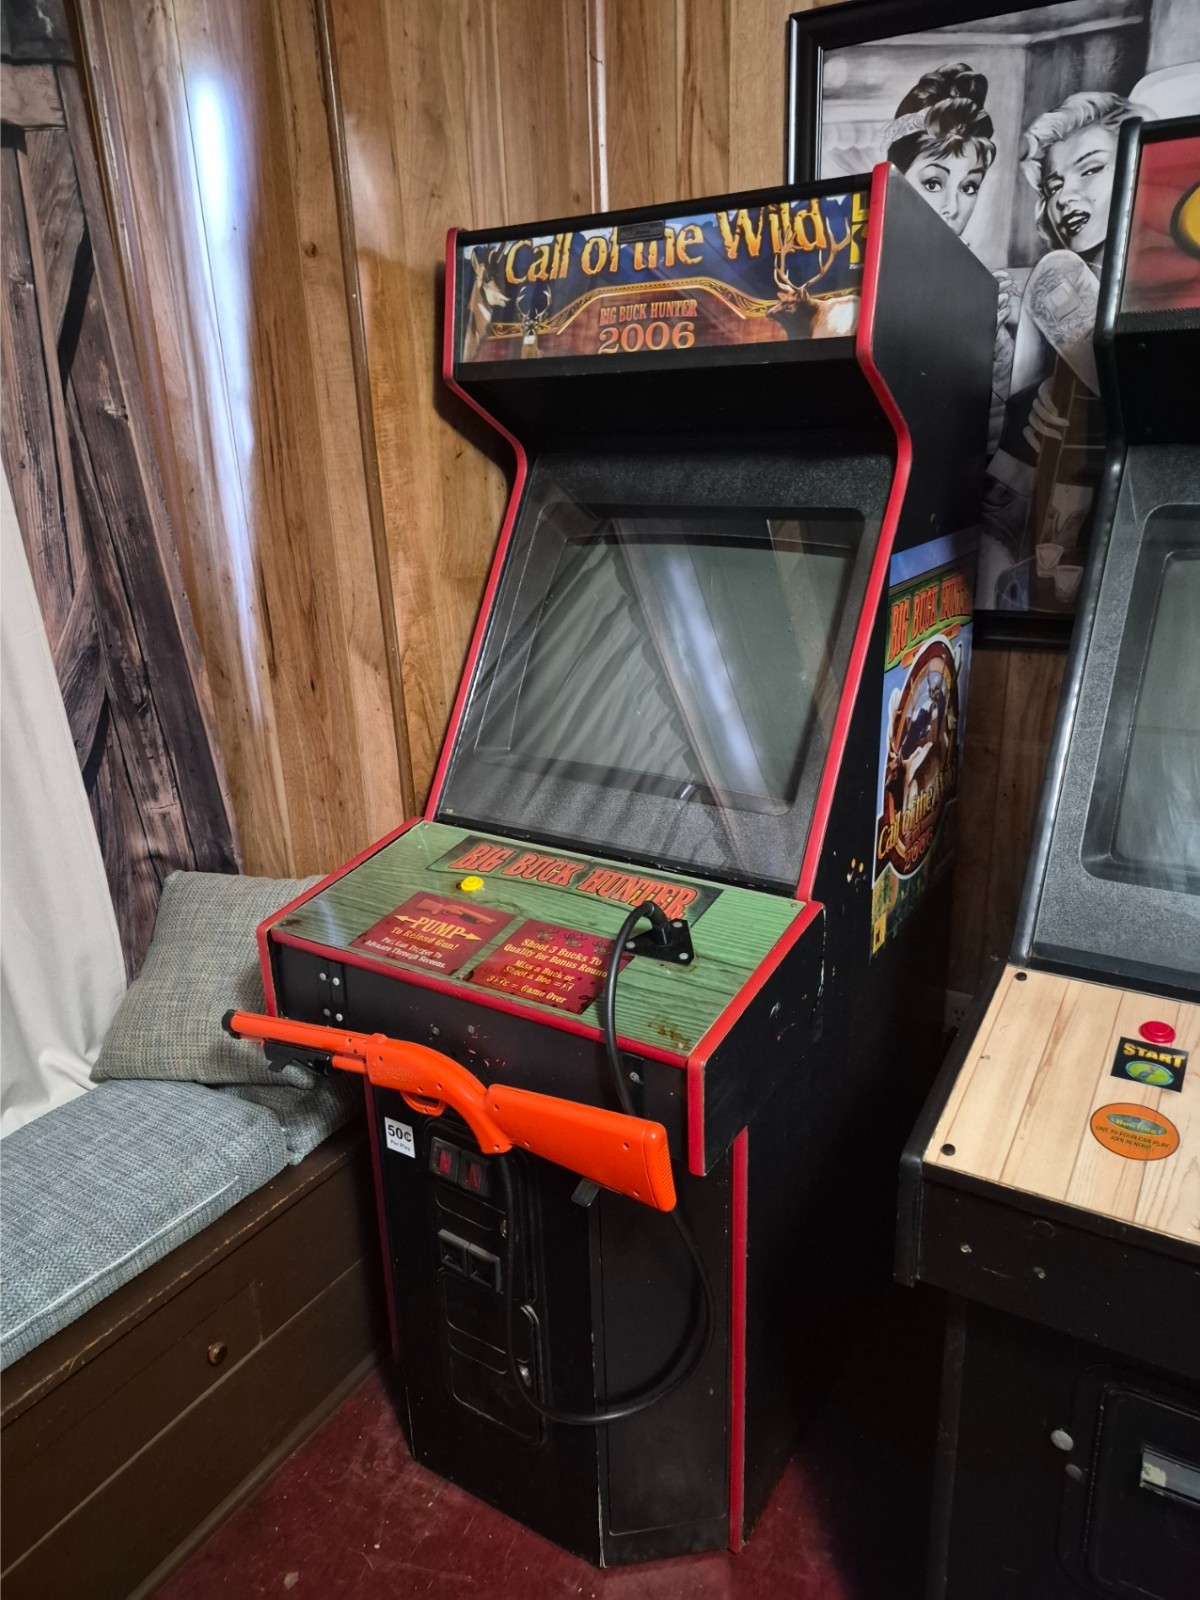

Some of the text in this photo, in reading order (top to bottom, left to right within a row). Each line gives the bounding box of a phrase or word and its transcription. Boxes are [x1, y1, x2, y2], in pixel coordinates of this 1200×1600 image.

[505, 231, 573, 284] Call
[716, 198, 826, 259] Wild
[599, 299, 698, 326] BIG BUCK HUNTER
[598, 321, 695, 354] 2006
[888, 598, 910, 664] BIG
[911, 584, 939, 641] BUCK
[878, 811, 901, 860] Call
[448, 844, 698, 921] BIG BUCK HUNTER
[390, 927, 460, 951] To Reload Gun!
[410, 916, 466, 939] PUMP
[392, 947, 419, 960] Through
[503, 943, 535, 958] Qualify
[534, 953, 549, 961] for
[549, 956, 578, 969] Bonus
[521, 938, 602, 966] Shoot 3 Bucks To
[503, 966, 528, 977] Shoot
[527, 972, 535, 980] a
[535, 974, 552, 985] Doe
[513, 960, 534, 970] Miss
[542, 967, 563, 979] Buck
[521, 985, 546, 997] Game
[546, 992, 567, 1004] Over
[1123, 1042, 1186, 1068] START
[388, 1124, 412, 1142] 50¢
